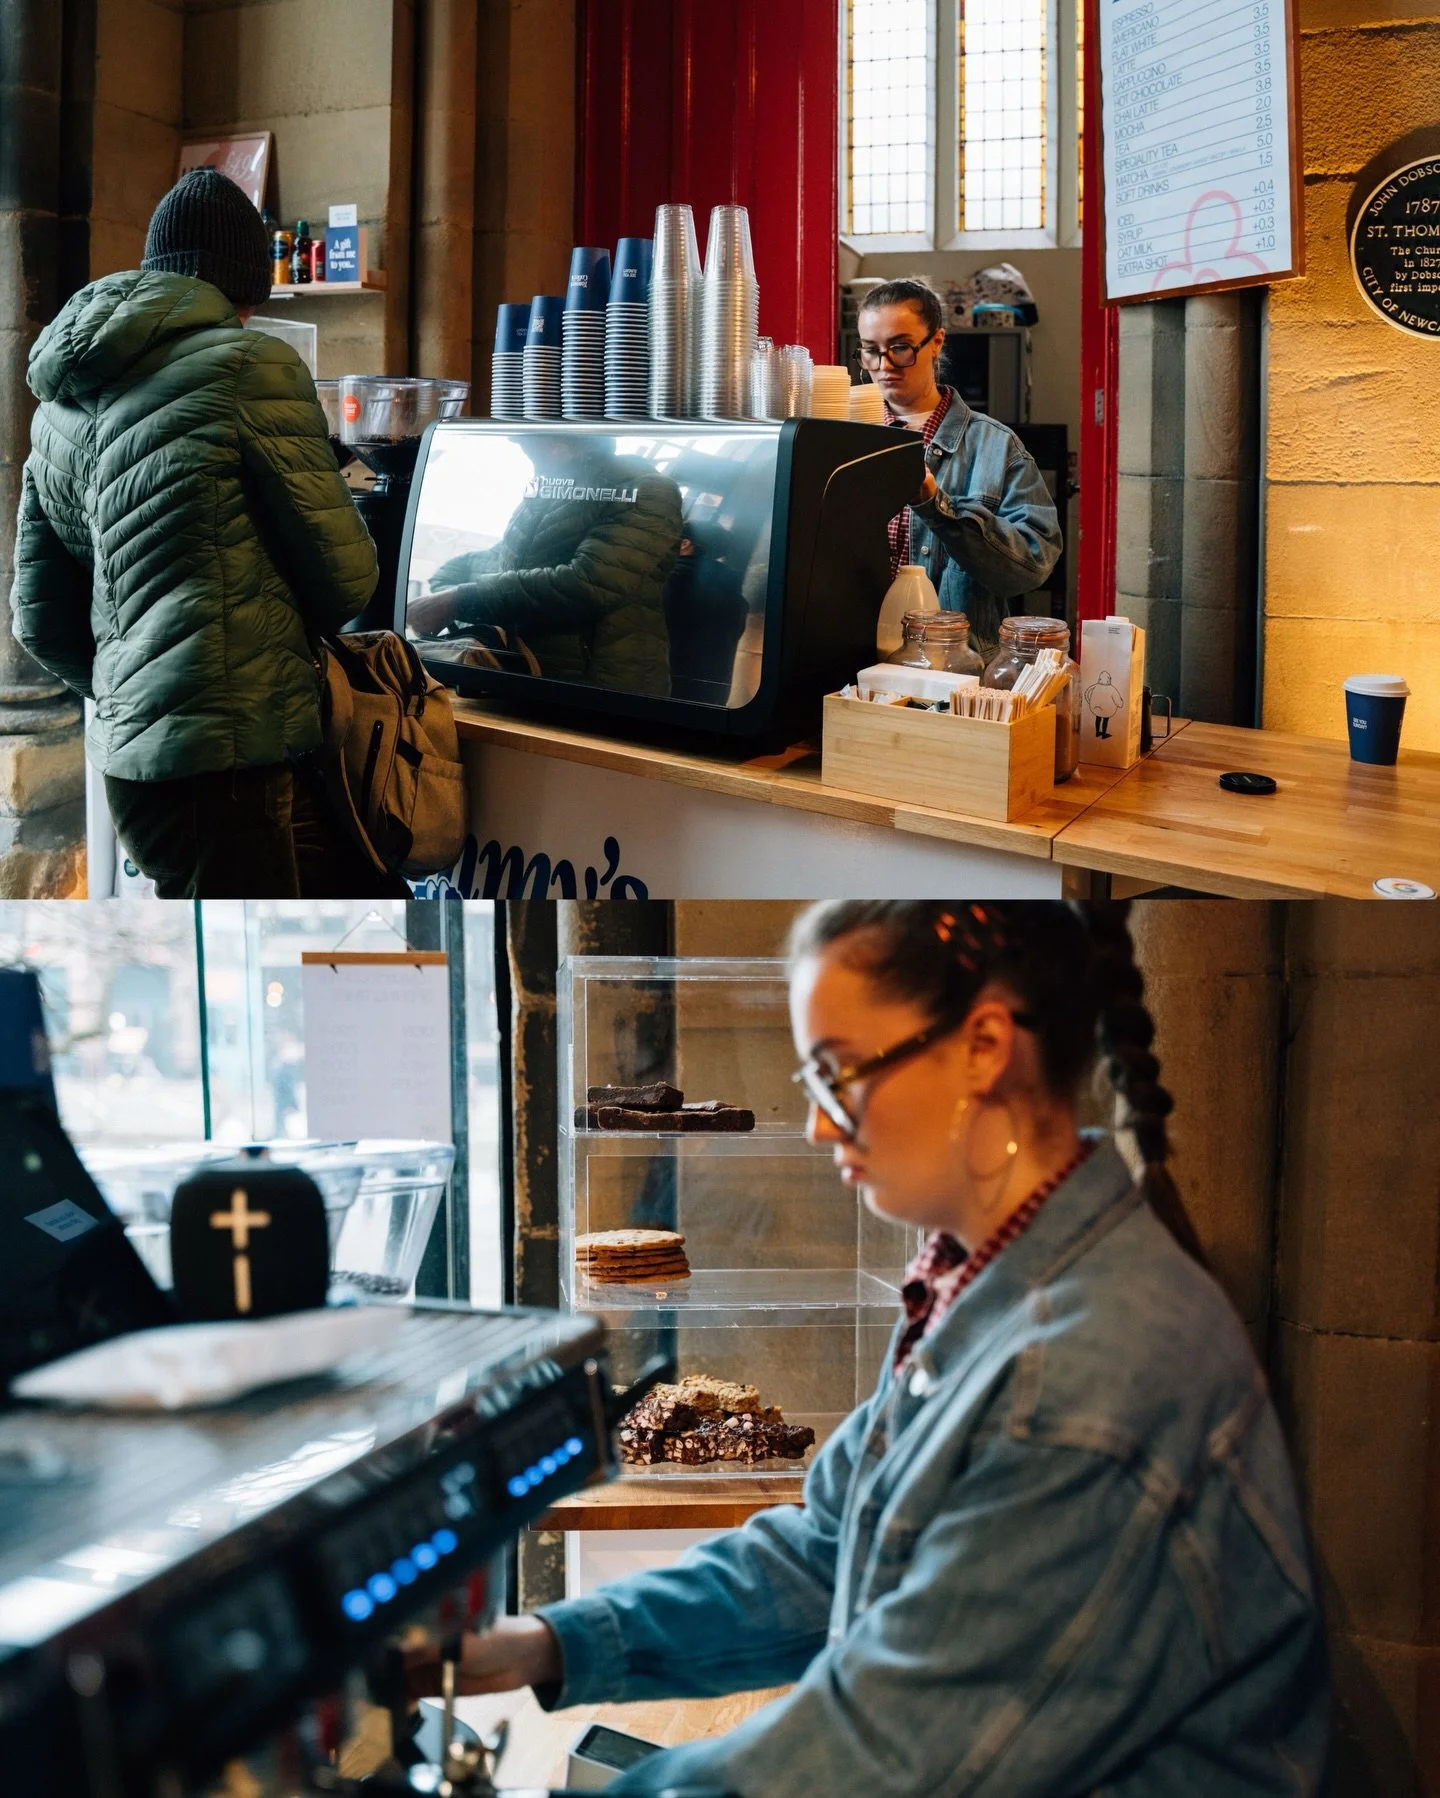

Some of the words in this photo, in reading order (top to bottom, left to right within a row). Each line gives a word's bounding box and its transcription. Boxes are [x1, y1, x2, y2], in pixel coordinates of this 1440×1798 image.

[1112, 2, 1154, 31] ESPRESSO
[1112, 15, 1159, 44] AMERICANO
[1112, 45, 1130, 61] FLAT
[1131, 32, 1158, 53] WHITE
[1113, 59, 1136, 78] LATTE
[1253, 3, 1269, 19] 3.5
[1113, 62, 1166, 93] CAPPUCCINO
[1254, 21, 1270, 37] 3.5
[1113, 93, 1129, 109] HOT
[1131, 72, 1183, 101] CHOCOLATE
[1254, 40, 1270, 56] 3.5
[1114, 108, 1133, 125] CHAI
[1133, 98, 1160, 117] LATTE
[1255, 59, 1271, 74] 3.5
[1115, 120, 1145, 139] MOCHA
[1255, 77, 1272, 92] 3.8
[1115, 143, 1130, 156] TEA
[1256, 95, 1271, 111] 2.0
[1115, 148, 1159, 173] SPECIALITY
[1161, 143, 1178, 158] TEA
[1256, 113, 1272, 129] 2.5
[1116, 168, 1149, 187] MATCHA
[1257, 132, 1273, 147] 5.0
[1116, 187, 1136, 204] SOFT
[1137, 179, 1169, 198] DRINKS
[1259, 151, 1273, 165] 1.5
[1117, 213, 1135, 227] ICED
[1252, 179, 1274, 194] +0.4
[1117, 227, 1143, 244] SYRUP
[1252, 197, 1274, 212] +0.3
[1370, 185, 1398, 217] JOHN
[1405, 197, 1440, 215] 1787
[1117, 245, 1133, 259] OAT
[1134, 241, 1153, 256] MILK
[1252, 216, 1275, 231] +0.3
[1367, 225, 1388, 238] ST.
[1390, 246, 1411, 256] The
[1117, 260, 1144, 276] EXTRA
[1145, 254, 1168, 271] SHOT
[1256, 235, 1275, 249] +1.0
[1395, 271, 1408, 282] by
[1403, 258, 1415, 268] in
[1363, 266, 1384, 296] CITY
[1382, 298, 1399, 313] OF
[1398, 310, 1440, 332] NEWC
[1390, 282, 1413, 293] first
[541, 475, 574, 486] nuova
